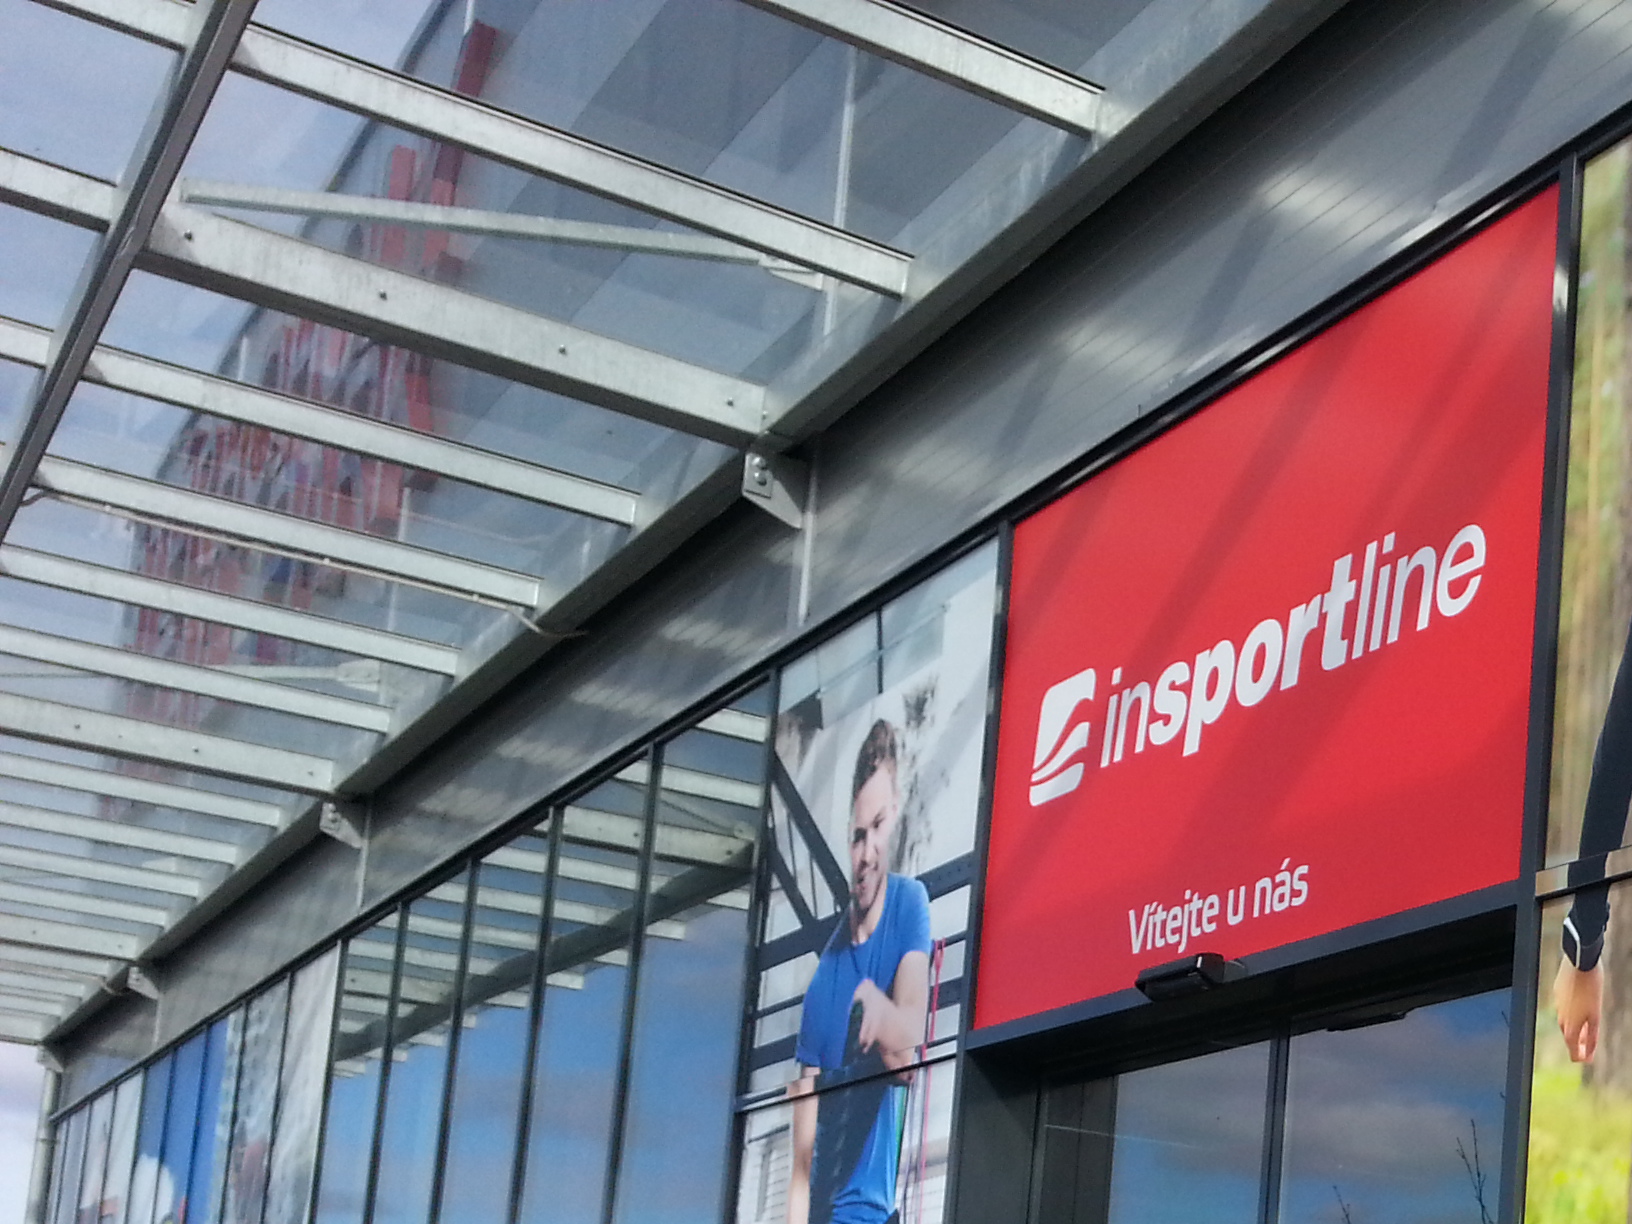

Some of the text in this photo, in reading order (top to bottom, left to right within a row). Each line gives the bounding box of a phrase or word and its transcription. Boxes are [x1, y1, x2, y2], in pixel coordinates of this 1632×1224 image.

[1100, 523, 1486, 768] insportline
[1127, 857, 1310, 955] Vítejte u nás
